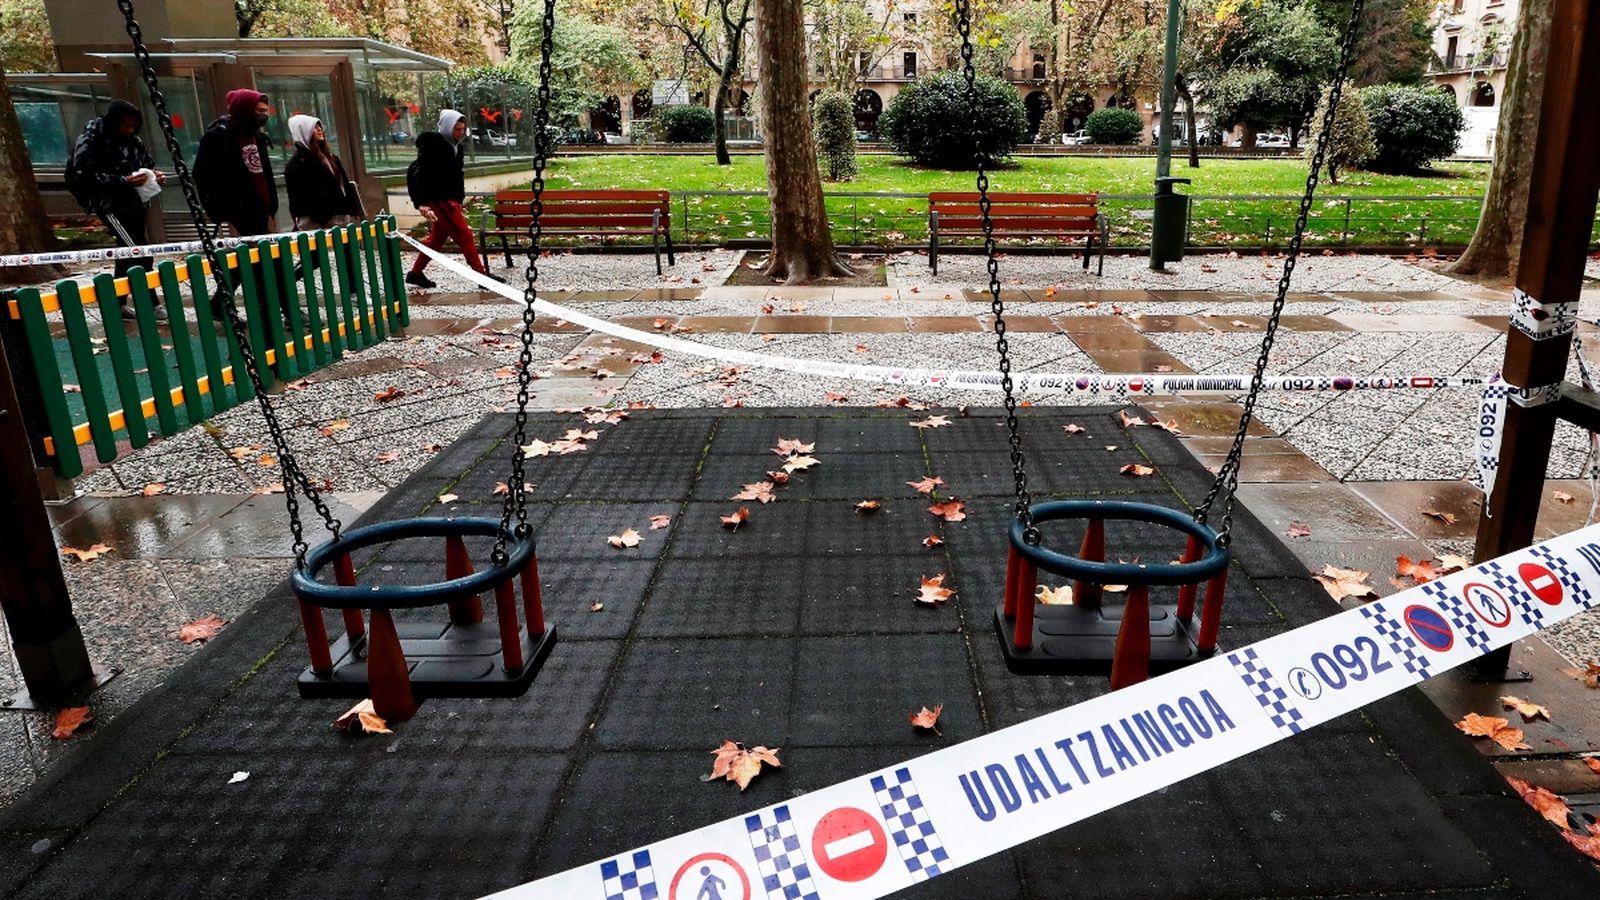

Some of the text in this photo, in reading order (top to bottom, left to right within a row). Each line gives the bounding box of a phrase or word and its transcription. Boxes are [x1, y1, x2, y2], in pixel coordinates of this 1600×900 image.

[1039, 377, 1063, 388] 092
[1196, 378, 1248, 391] MUNICIPAL
[1282, 378, 1315, 391] 092
[1479, 402, 1497, 438] 092
[1310, 636, 1393, 690] 092
[958, 689, 1236, 822] UDALTZAINGOA
